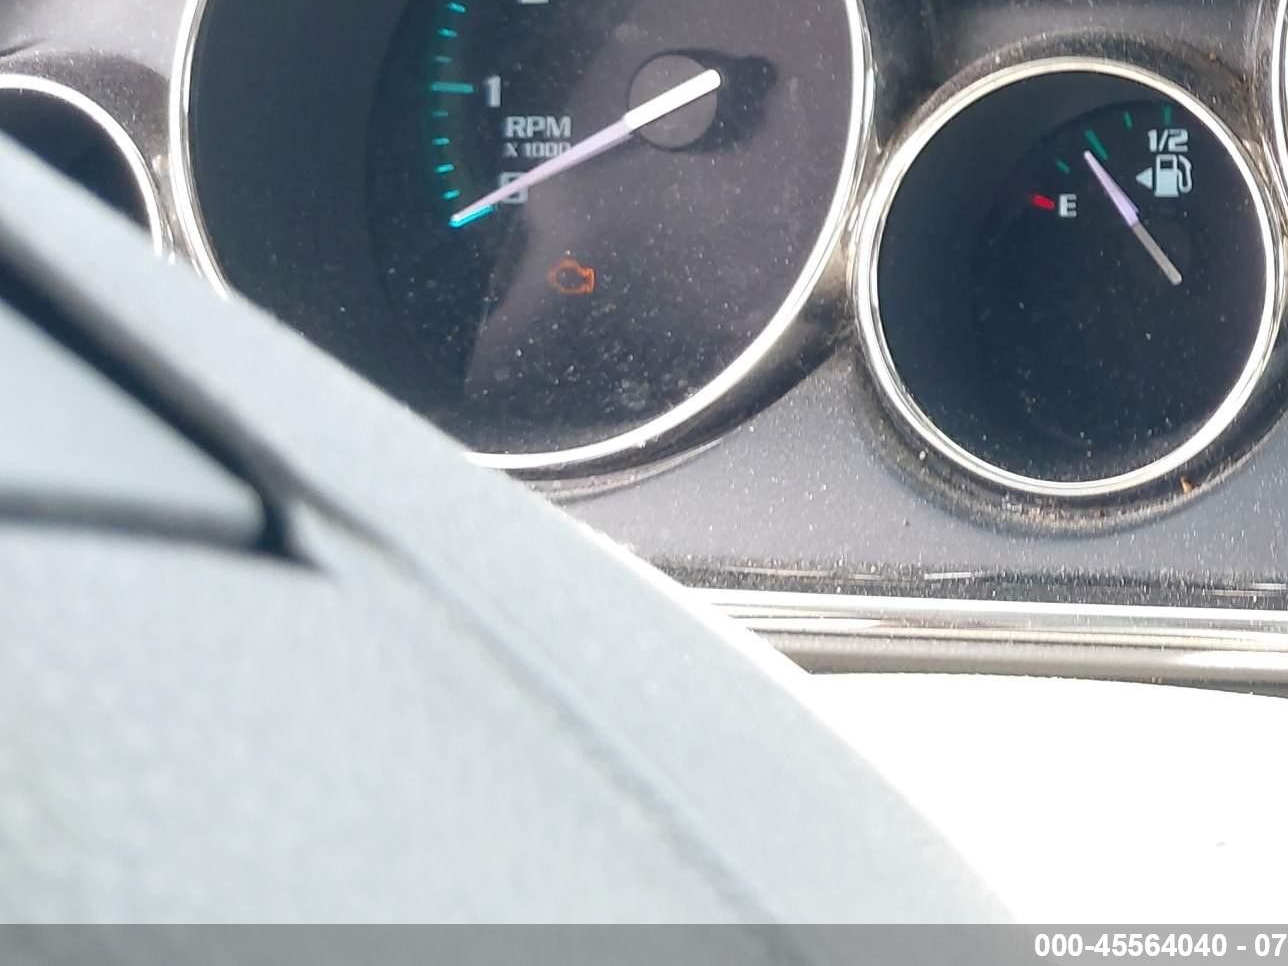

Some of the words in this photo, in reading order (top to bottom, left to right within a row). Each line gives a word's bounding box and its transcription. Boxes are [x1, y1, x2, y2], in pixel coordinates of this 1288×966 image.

[484, 77, 501, 107] 1
[505, 116, 571, 138] RPM
[504, 142, 519, 158] X
[1148, 129, 1188, 152] 1/2
[1059, 194, 1077, 218] E
